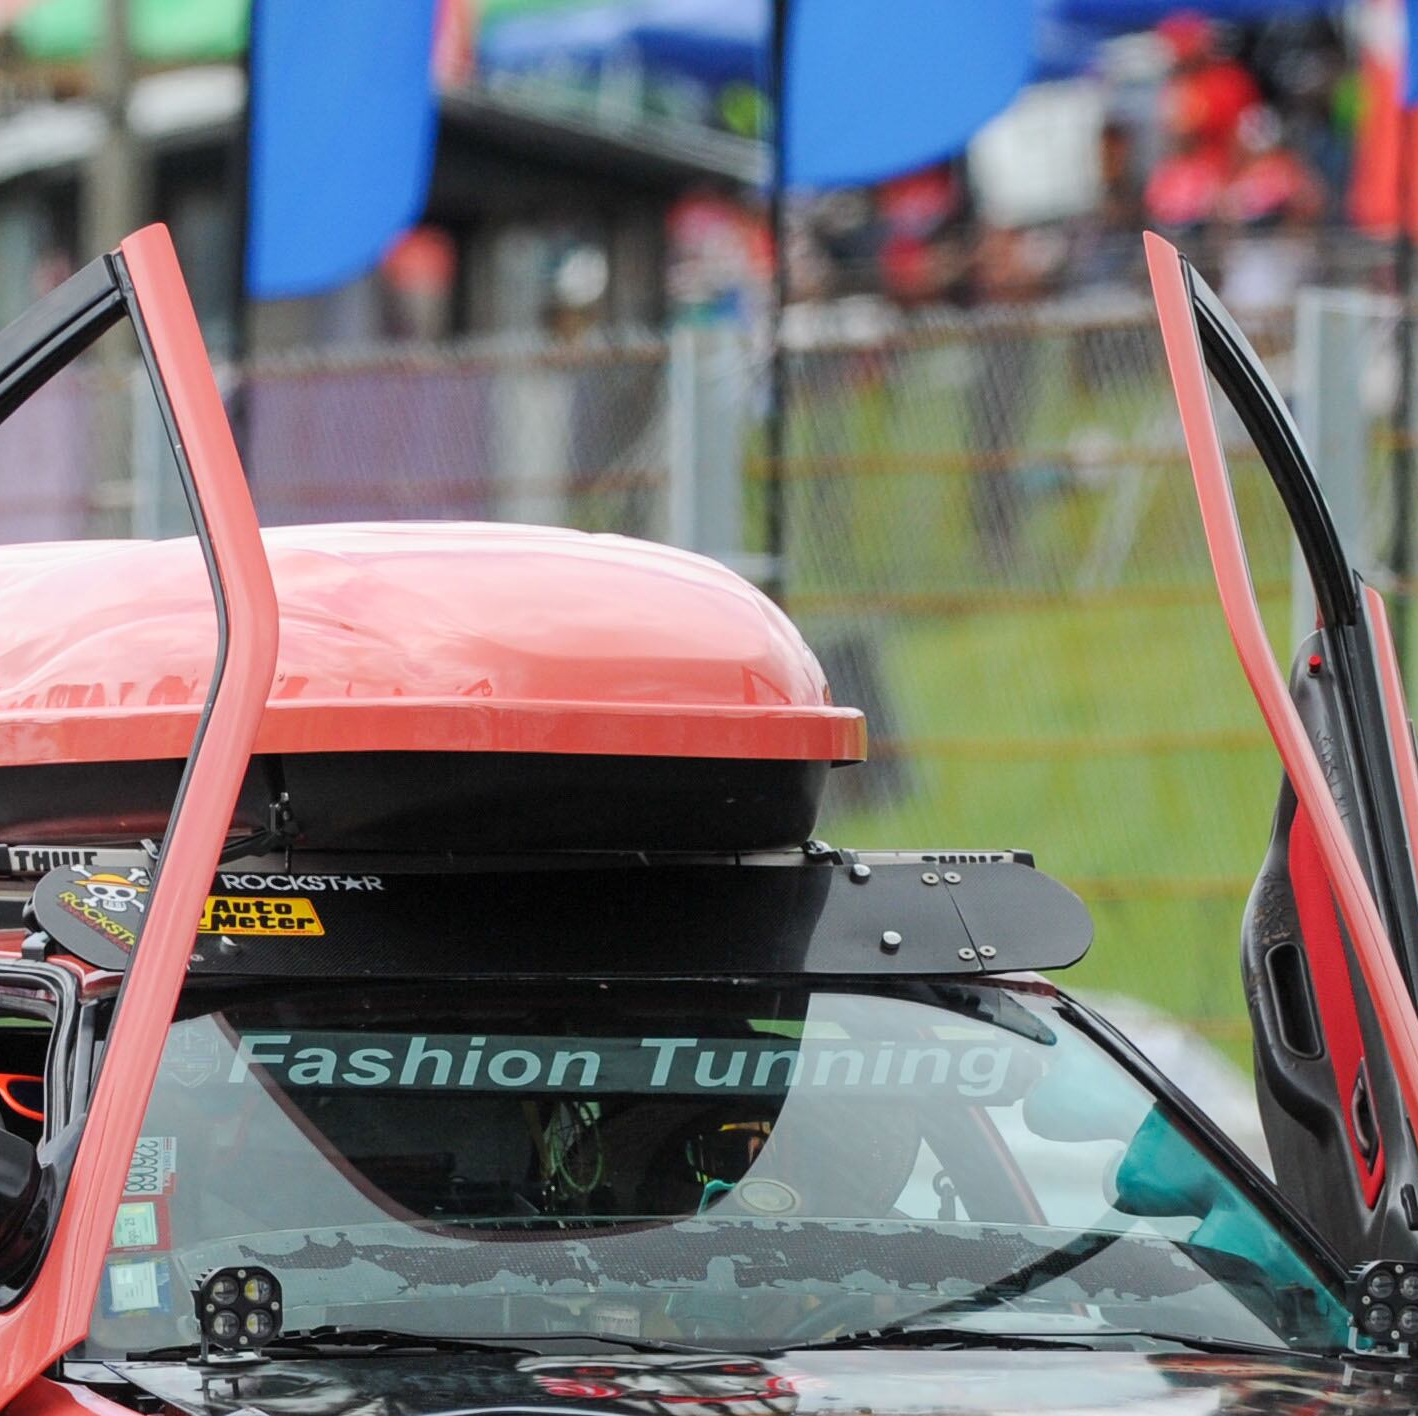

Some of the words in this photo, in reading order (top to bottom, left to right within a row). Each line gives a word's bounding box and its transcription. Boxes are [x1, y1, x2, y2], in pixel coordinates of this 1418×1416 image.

[212, 900, 293, 915] Auto
[211, 914, 316, 932] Meter
[227, 1034, 601, 1087] Fashion
[640, 1037, 1012, 1098] Tunning
